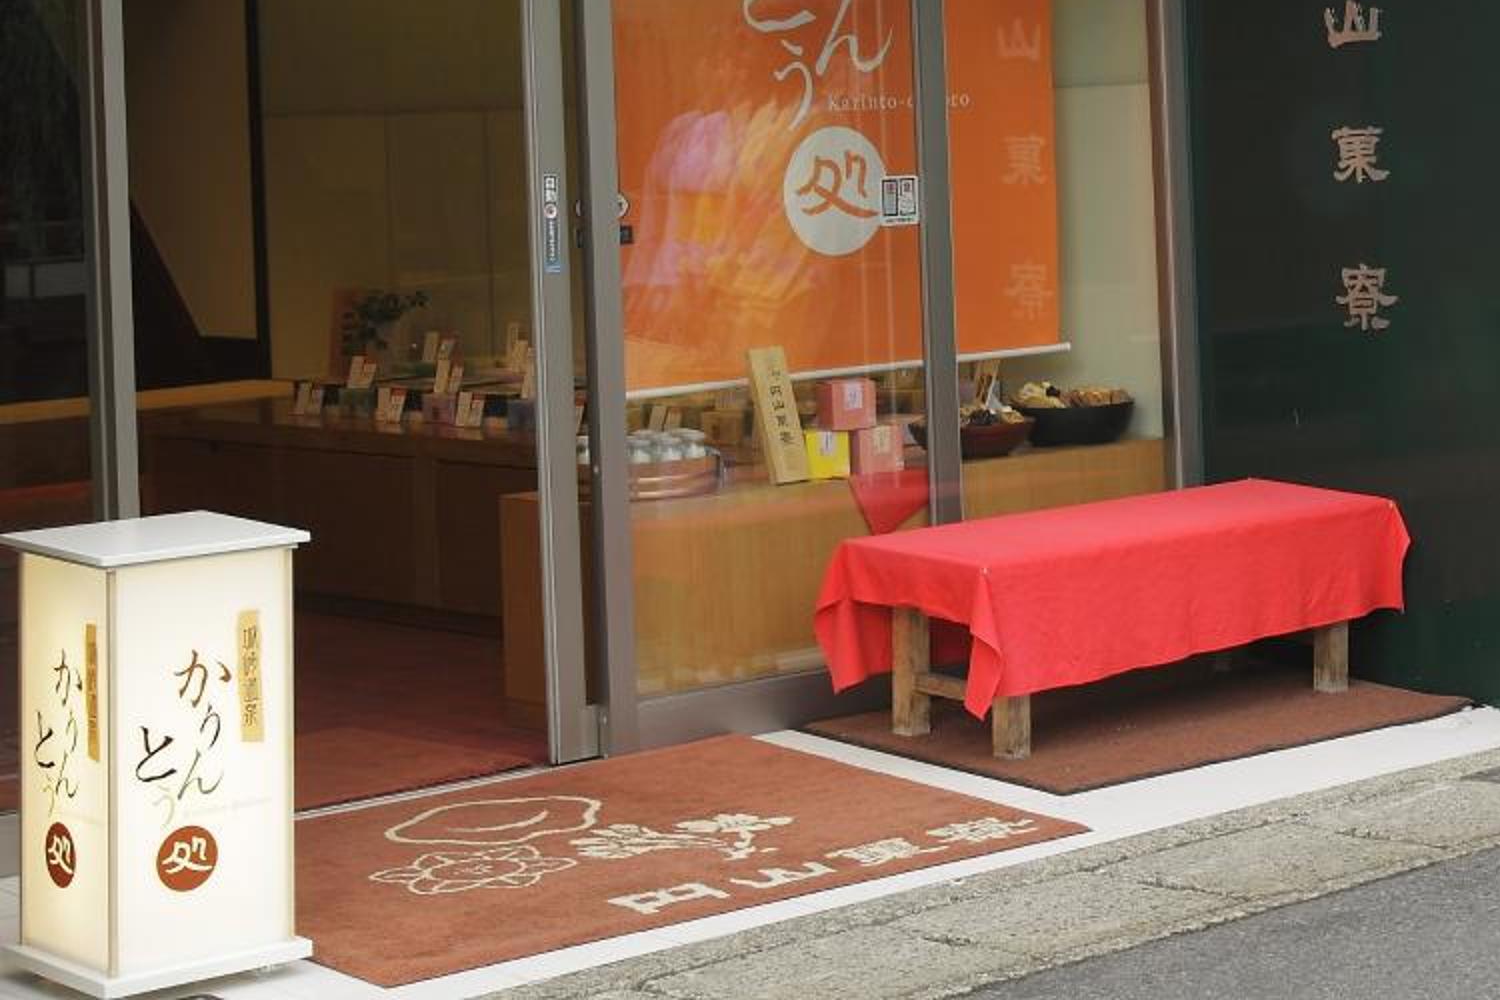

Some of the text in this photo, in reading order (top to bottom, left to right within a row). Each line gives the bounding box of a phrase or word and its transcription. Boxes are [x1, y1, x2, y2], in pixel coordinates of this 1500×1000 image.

[795, 150, 879, 217] 処
[174, 649, 232, 801] かりん
